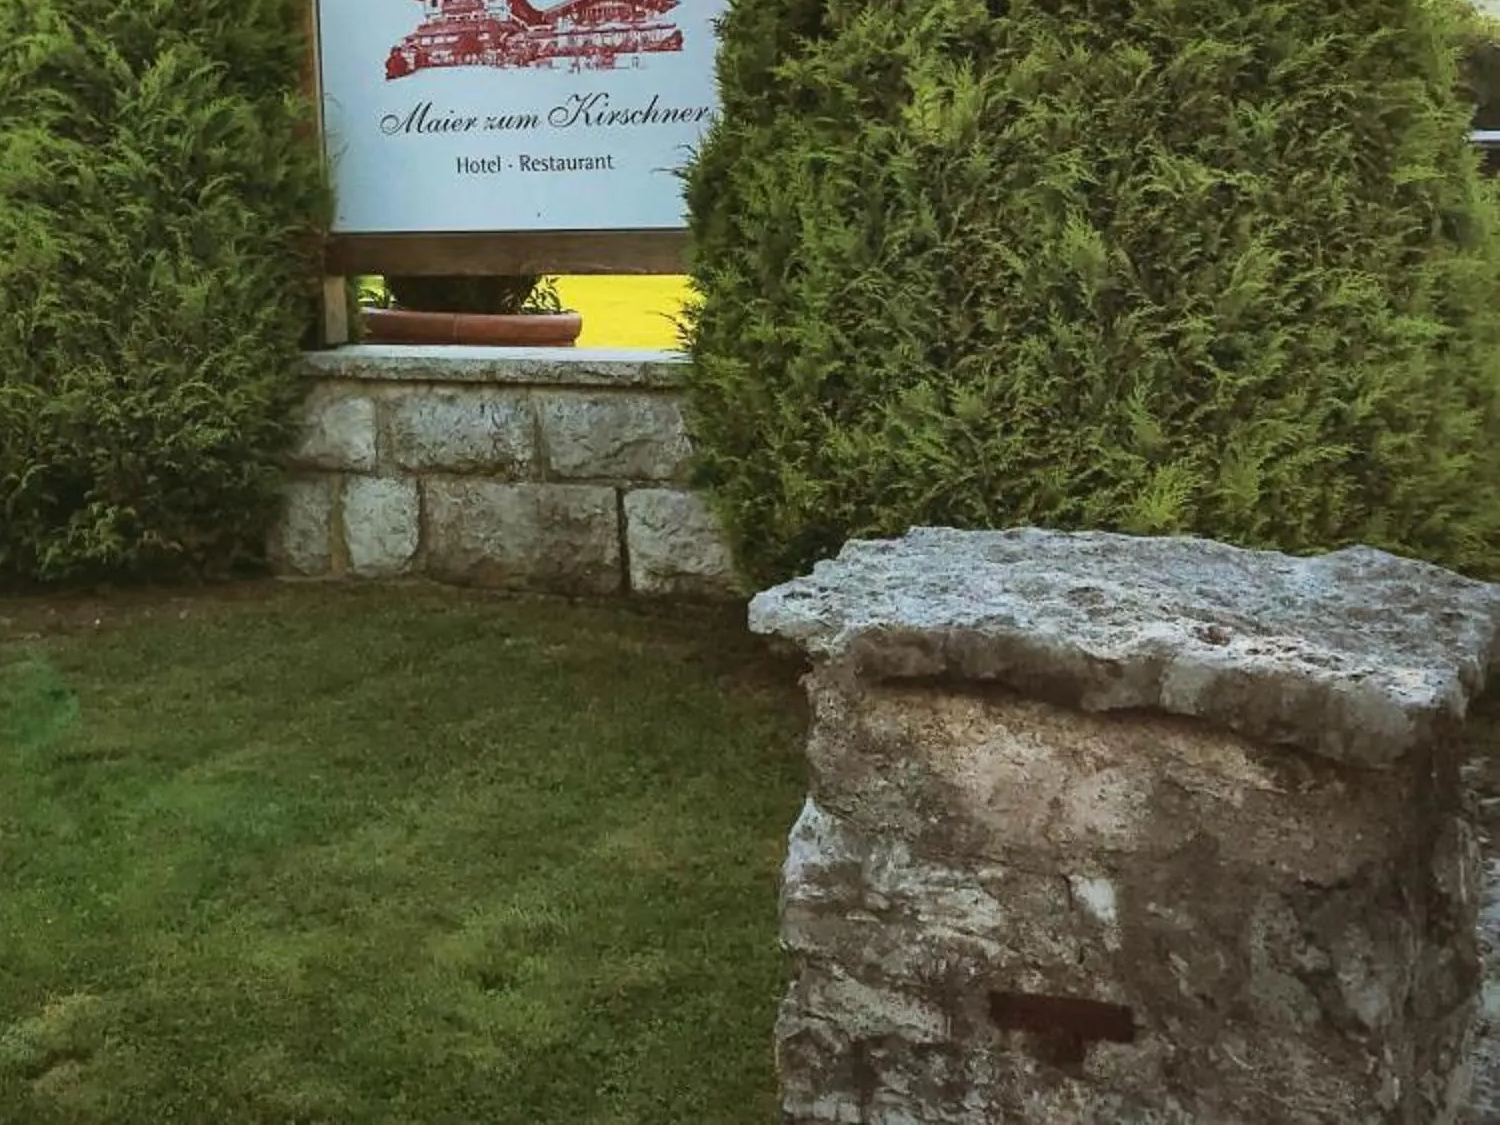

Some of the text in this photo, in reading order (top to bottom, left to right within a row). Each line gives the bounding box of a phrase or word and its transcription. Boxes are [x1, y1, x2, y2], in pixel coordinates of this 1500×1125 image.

[379, 91, 711, 136] Maier zum Kirschner
[455, 155, 502, 175] Hotel
[518, 153, 617, 173] Restaurant
